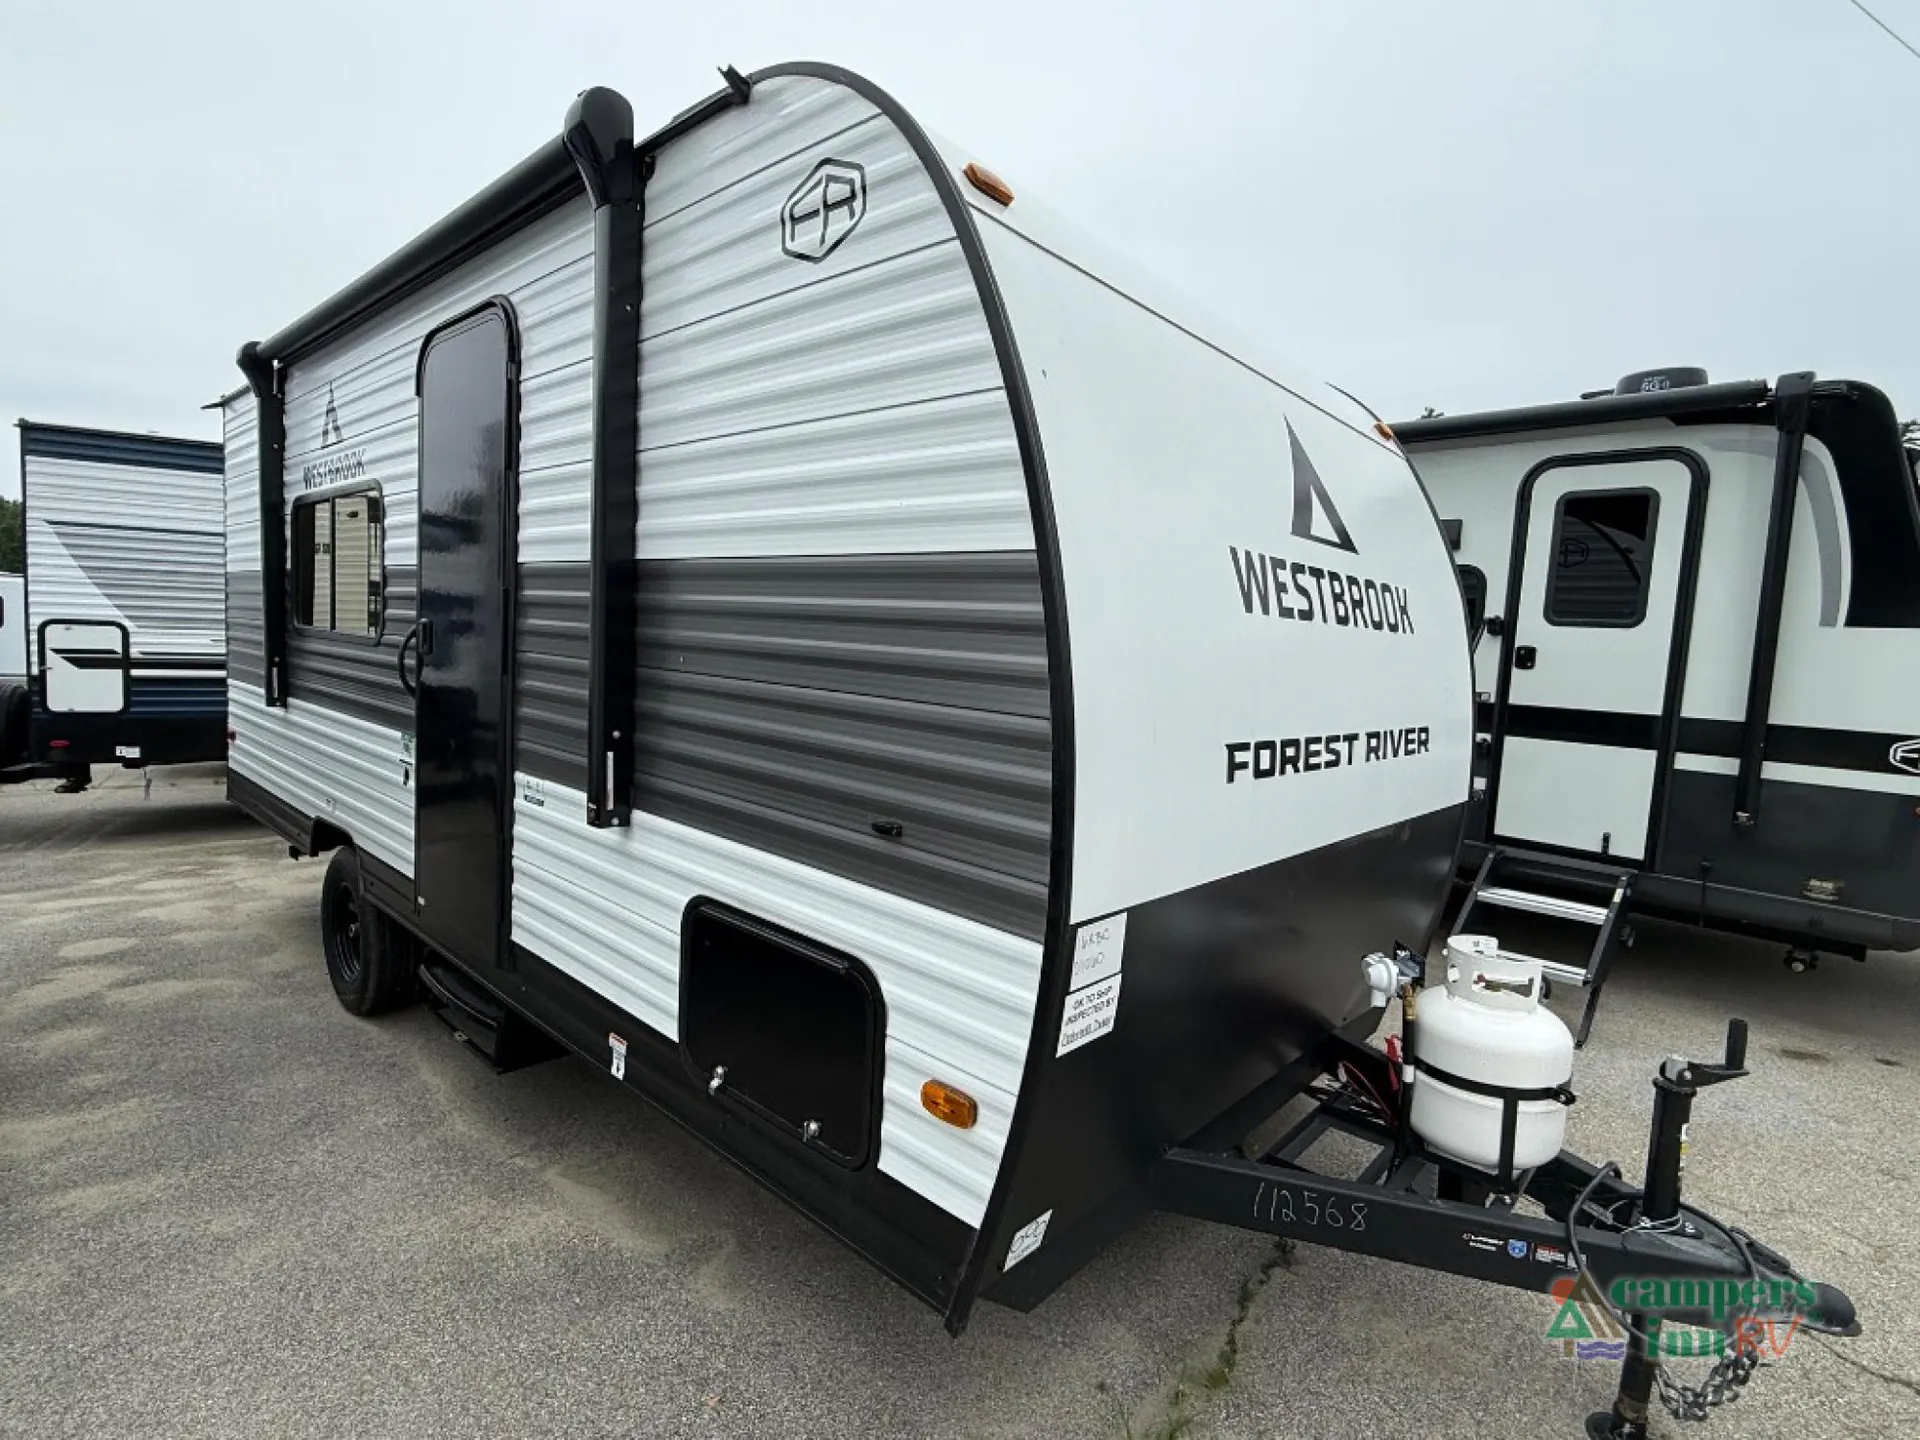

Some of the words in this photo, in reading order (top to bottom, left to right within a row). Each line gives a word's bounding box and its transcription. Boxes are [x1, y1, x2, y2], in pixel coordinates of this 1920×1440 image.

[303, 448, 366, 490] WESTBROOK
[1229, 545, 1414, 634] WESTBROOK
[1224, 733, 1360, 784] FOREST
[1365, 725, 1430, 763] RIVER
[1254, 1181, 1368, 1231] 112568
